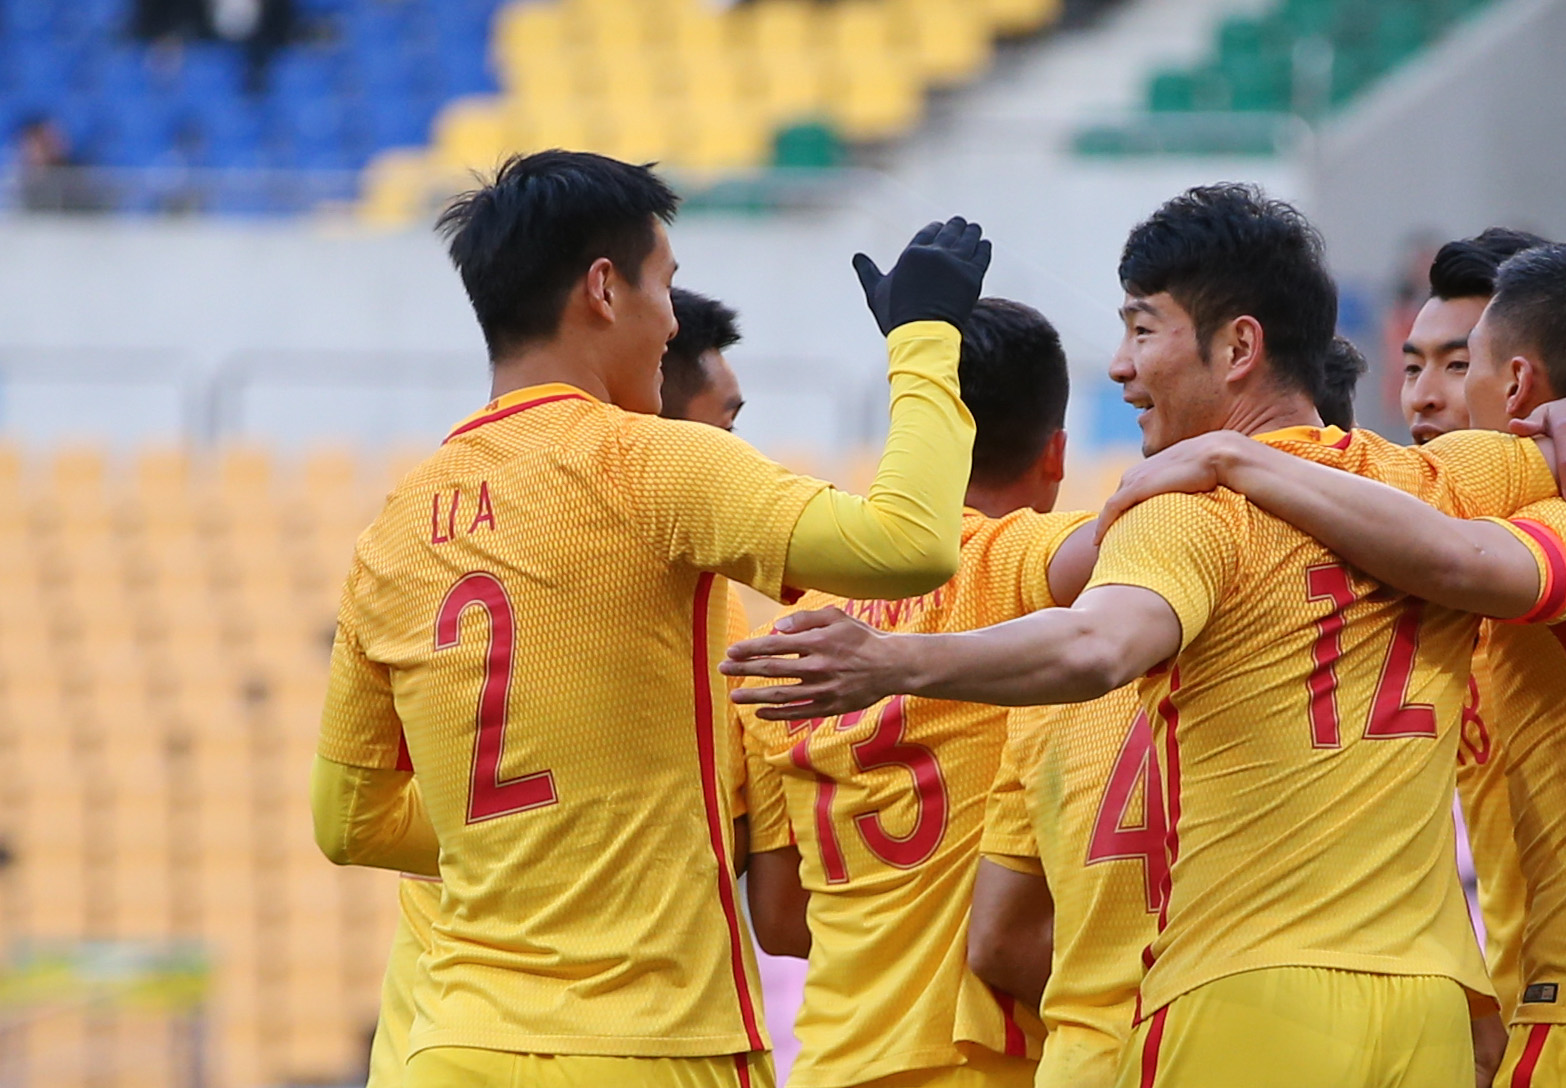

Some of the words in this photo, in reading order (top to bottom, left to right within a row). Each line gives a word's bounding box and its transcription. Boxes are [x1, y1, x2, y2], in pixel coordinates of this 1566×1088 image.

[434, 570, 559, 826] 2
[1306, 562, 1438, 749] 12
[1084, 705, 1170, 914] 4
